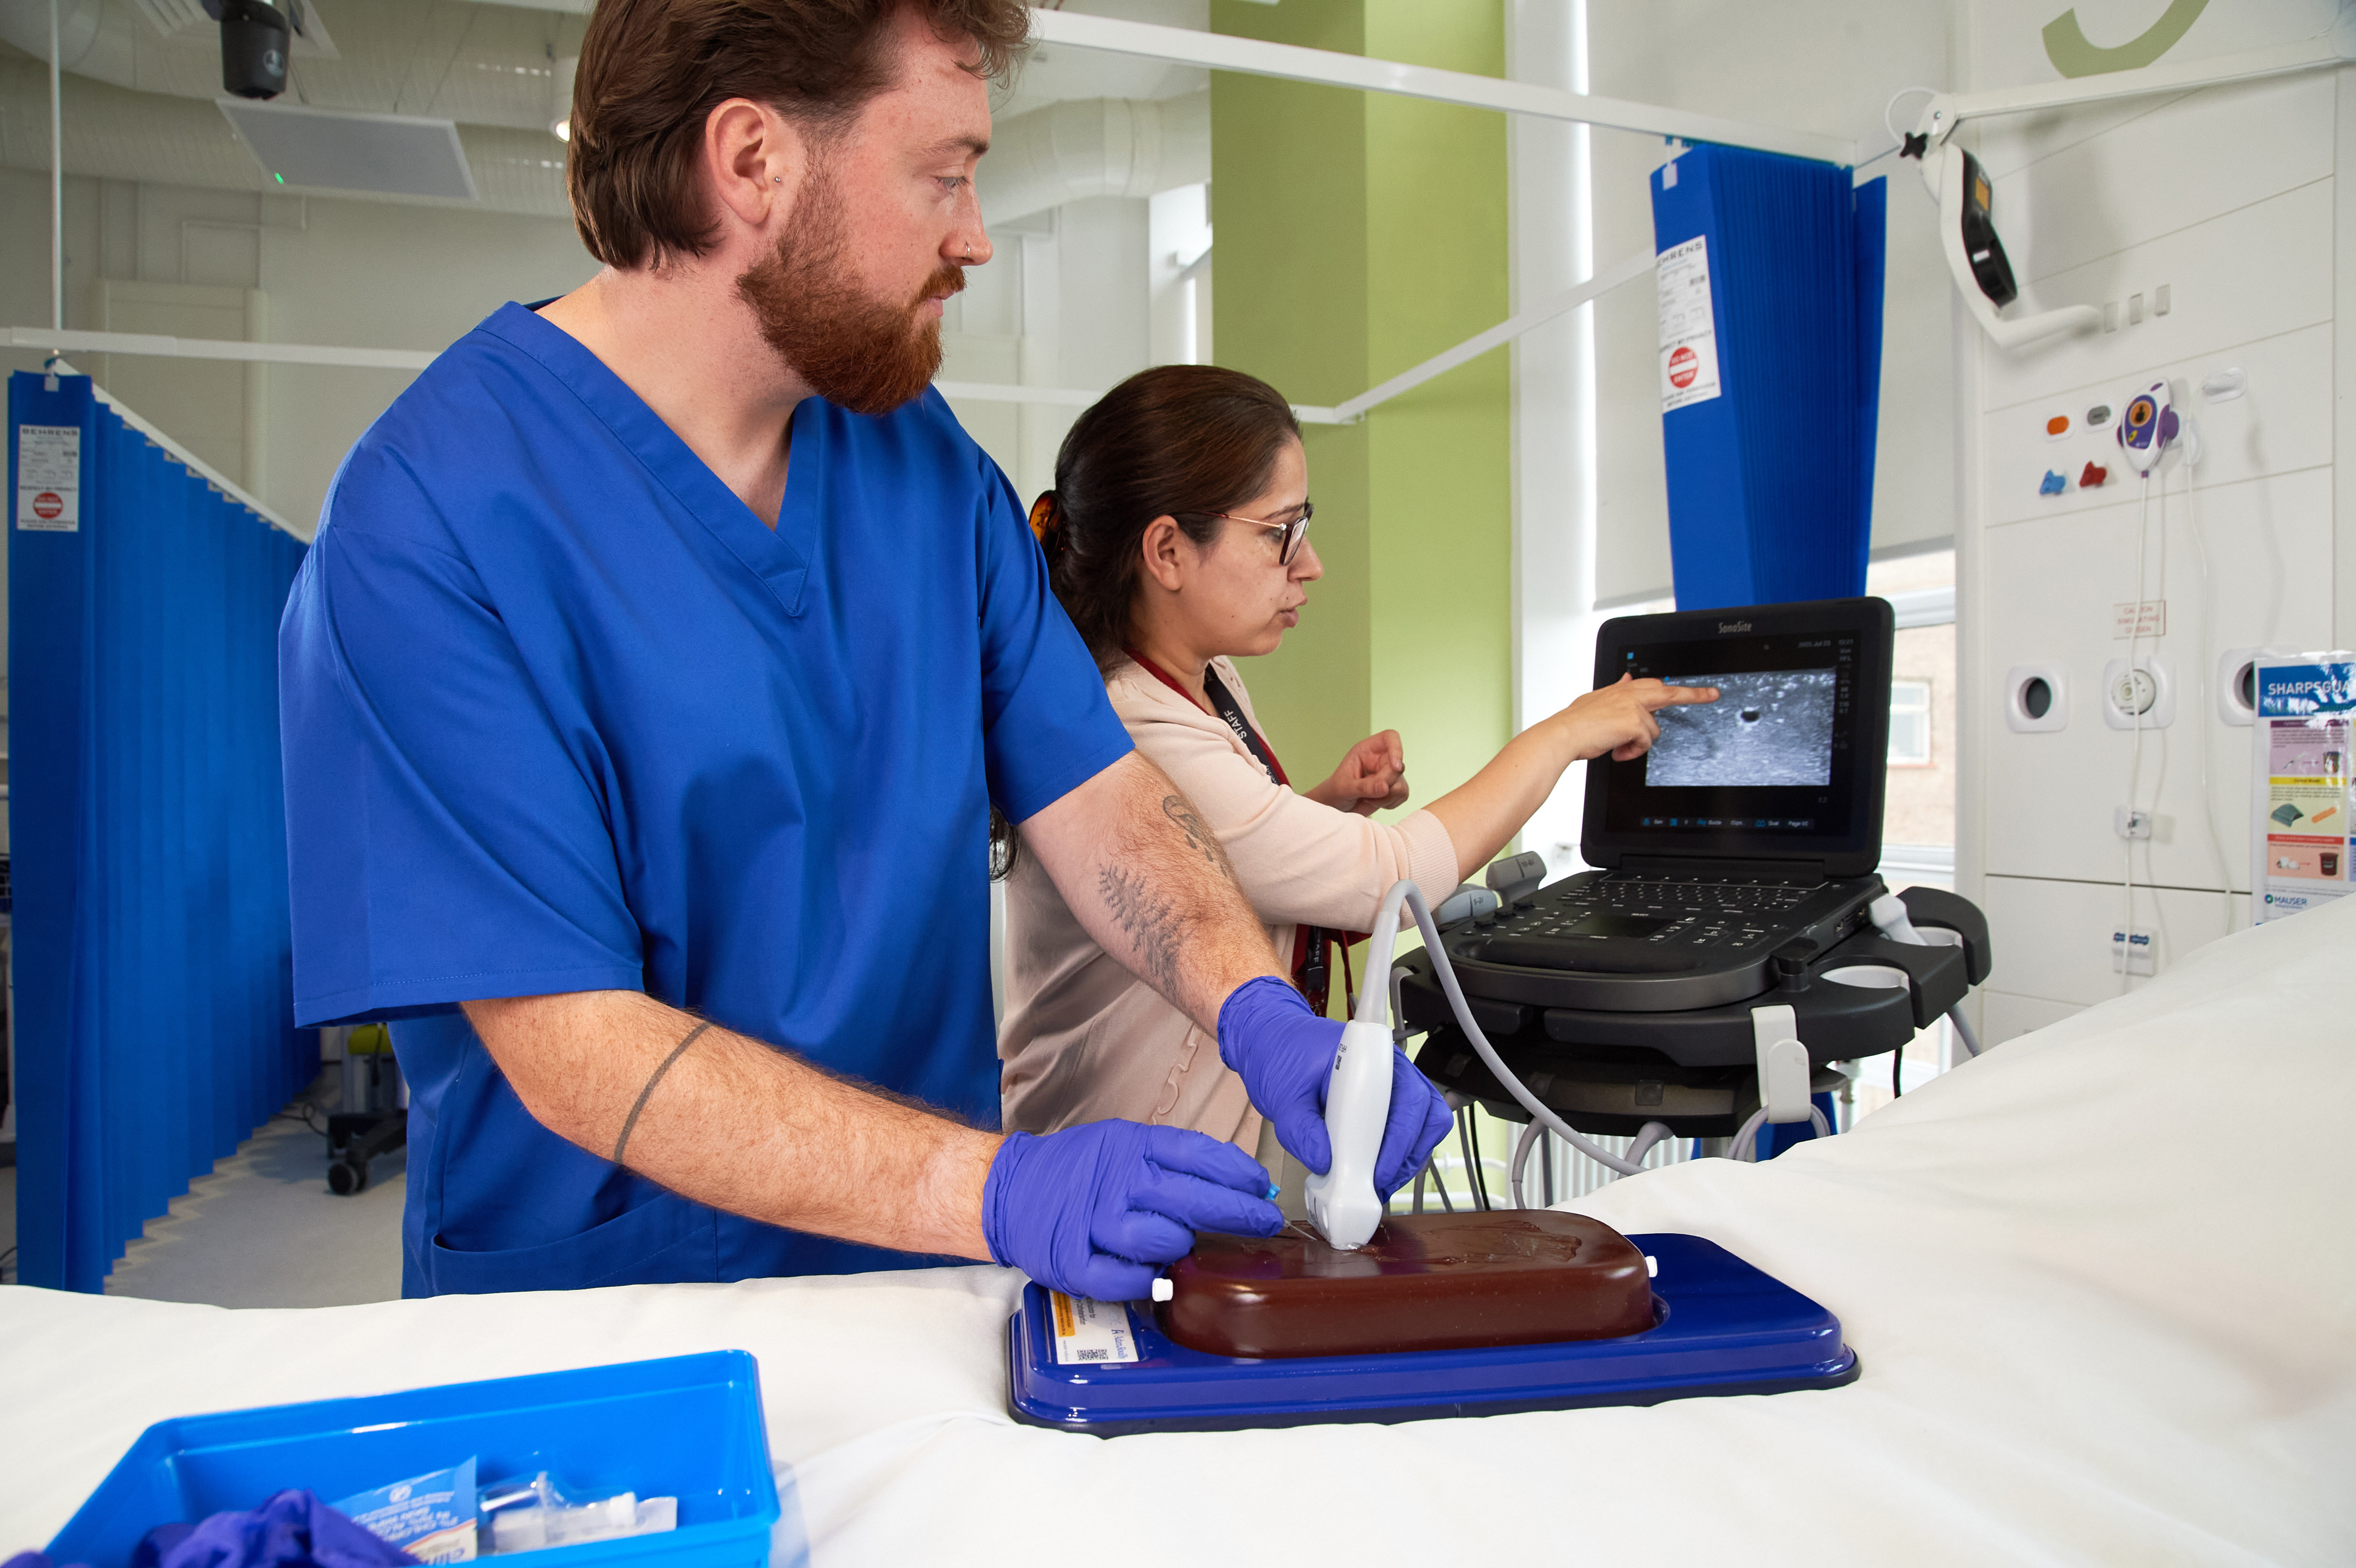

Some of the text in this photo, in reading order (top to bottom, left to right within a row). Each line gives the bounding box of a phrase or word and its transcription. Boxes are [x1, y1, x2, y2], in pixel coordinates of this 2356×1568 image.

[22, 428, 78, 436] BEHRENS
[1718, 621, 1753, 634] SonoSite
[1223, 709, 1247, 740] STAFF
[2274, 896, 2307, 906] MAUSER
